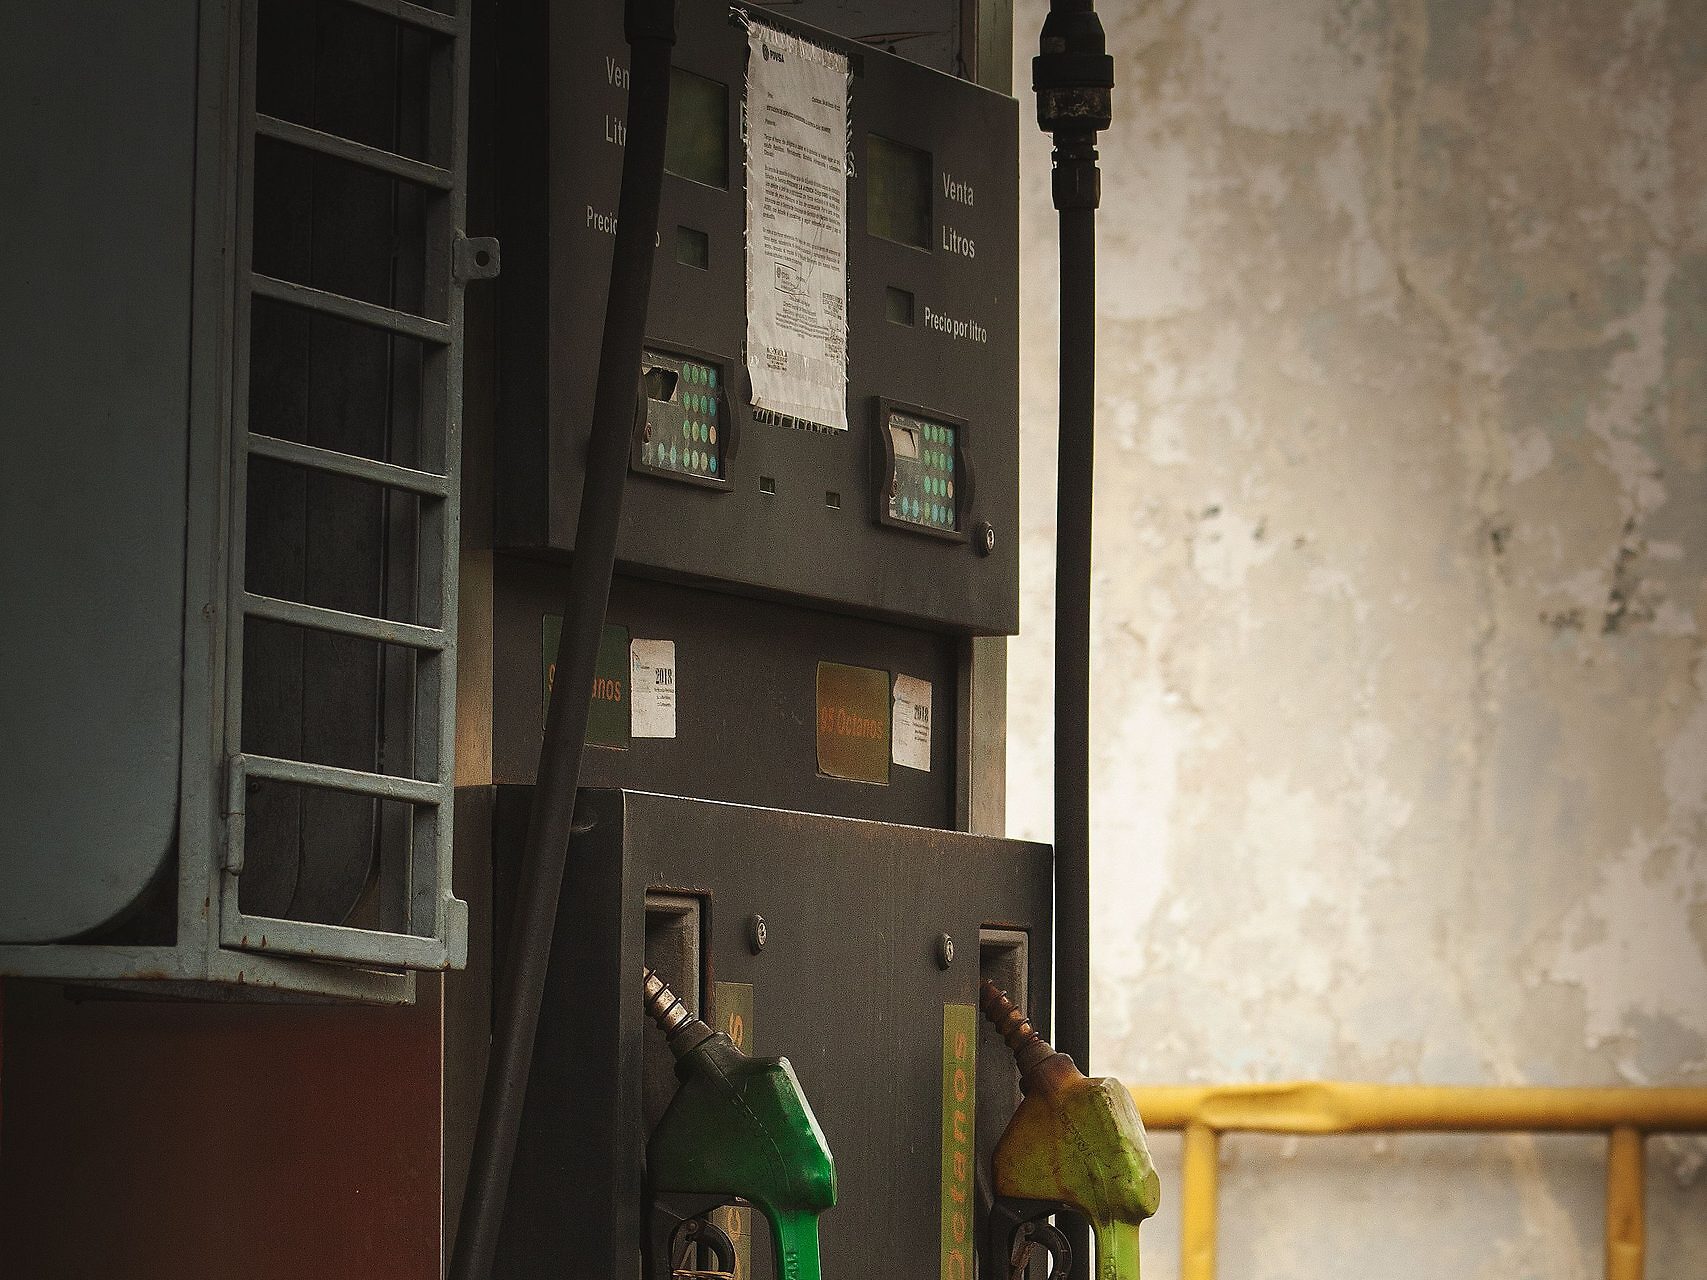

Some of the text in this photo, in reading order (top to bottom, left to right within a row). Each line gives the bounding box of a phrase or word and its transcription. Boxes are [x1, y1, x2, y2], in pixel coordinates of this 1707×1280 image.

[605, 55, 630, 91] Ven
[942, 171, 974, 207] Venta
[942, 225, 975, 259] Litros
[924, 306, 987, 344] Precio por litro
[655, 667, 673, 685] 2018
